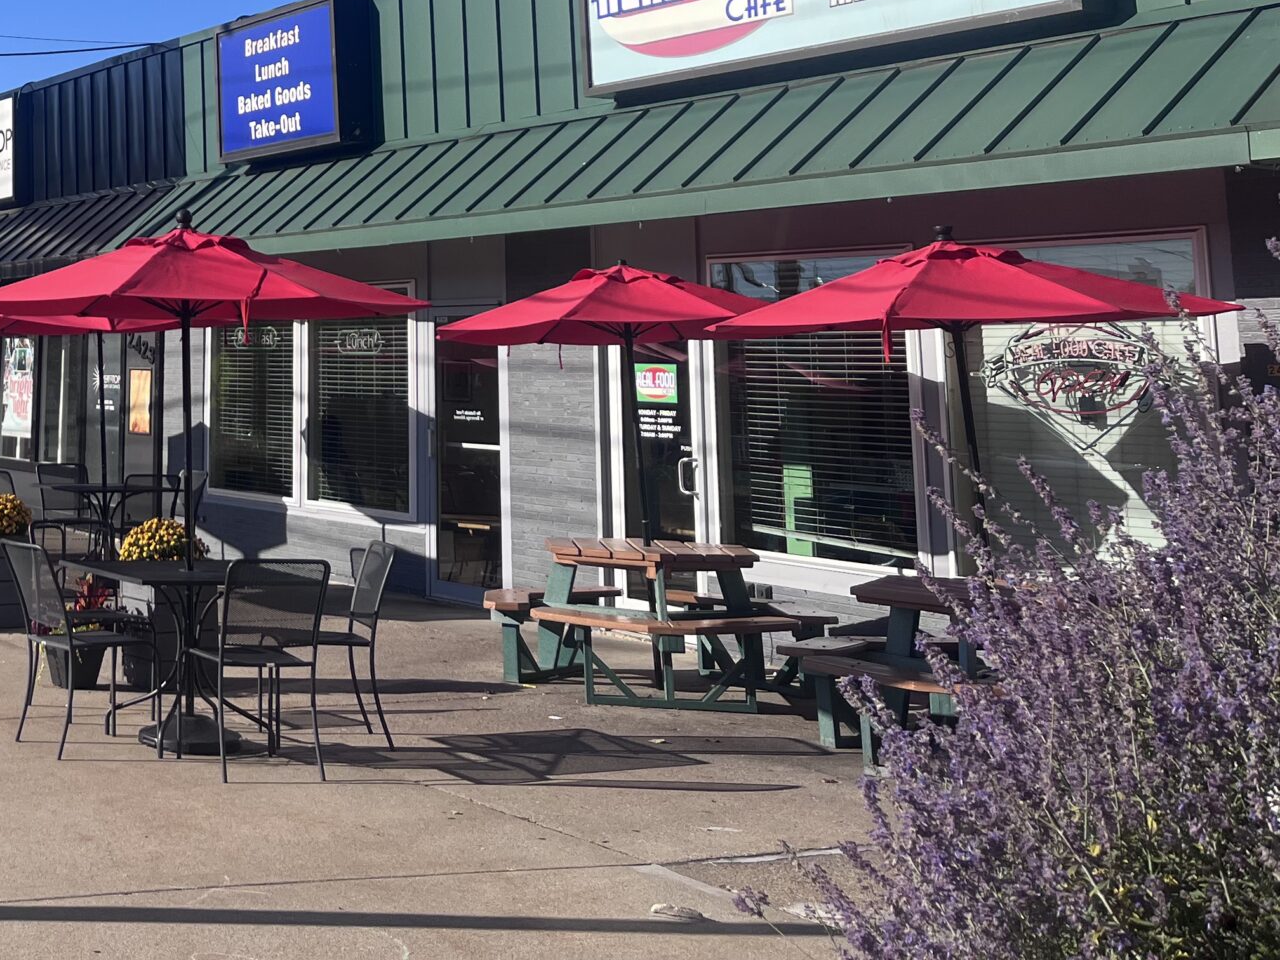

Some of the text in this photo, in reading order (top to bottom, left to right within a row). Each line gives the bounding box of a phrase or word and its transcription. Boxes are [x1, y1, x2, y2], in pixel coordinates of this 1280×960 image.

[245, 25, 300, 57] Breakfast
[255, 57, 289, 82] Lunch
[237, 81, 311, 115] Baked Goods
[249, 112, 301, 140] Take-Out
[128, 333, 155, 365] 2423
[636, 371, 675, 388] REAL FOOD
